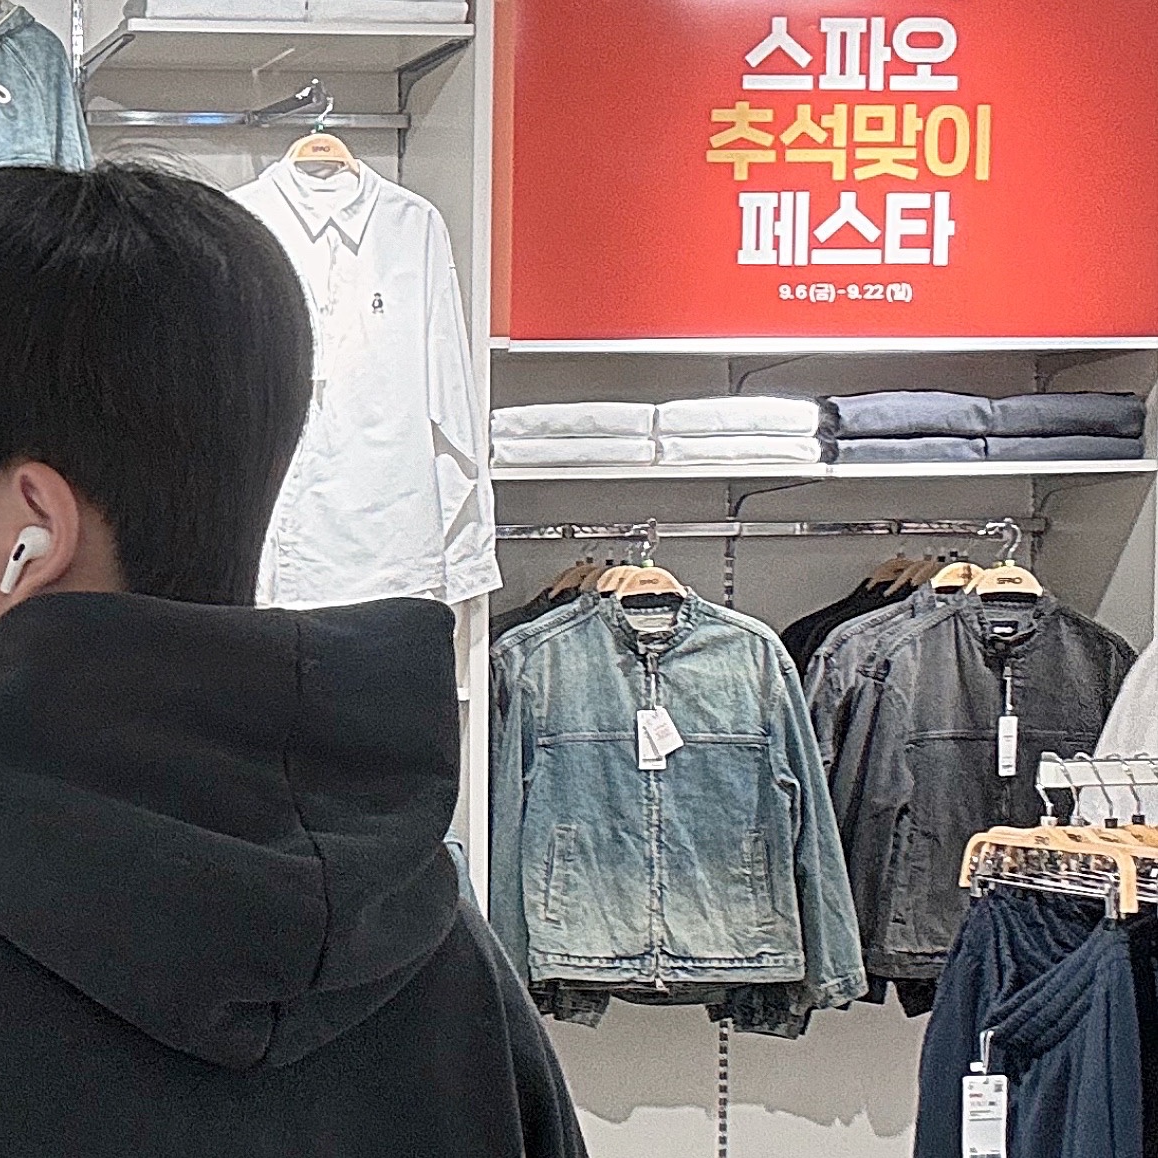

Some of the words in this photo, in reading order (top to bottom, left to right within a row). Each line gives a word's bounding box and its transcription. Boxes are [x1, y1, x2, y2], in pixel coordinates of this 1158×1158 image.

[742, 16, 959, 92] 스파오
[706, 101, 992, 181] 추석맞이
[737, 191, 956, 266] 페스타
